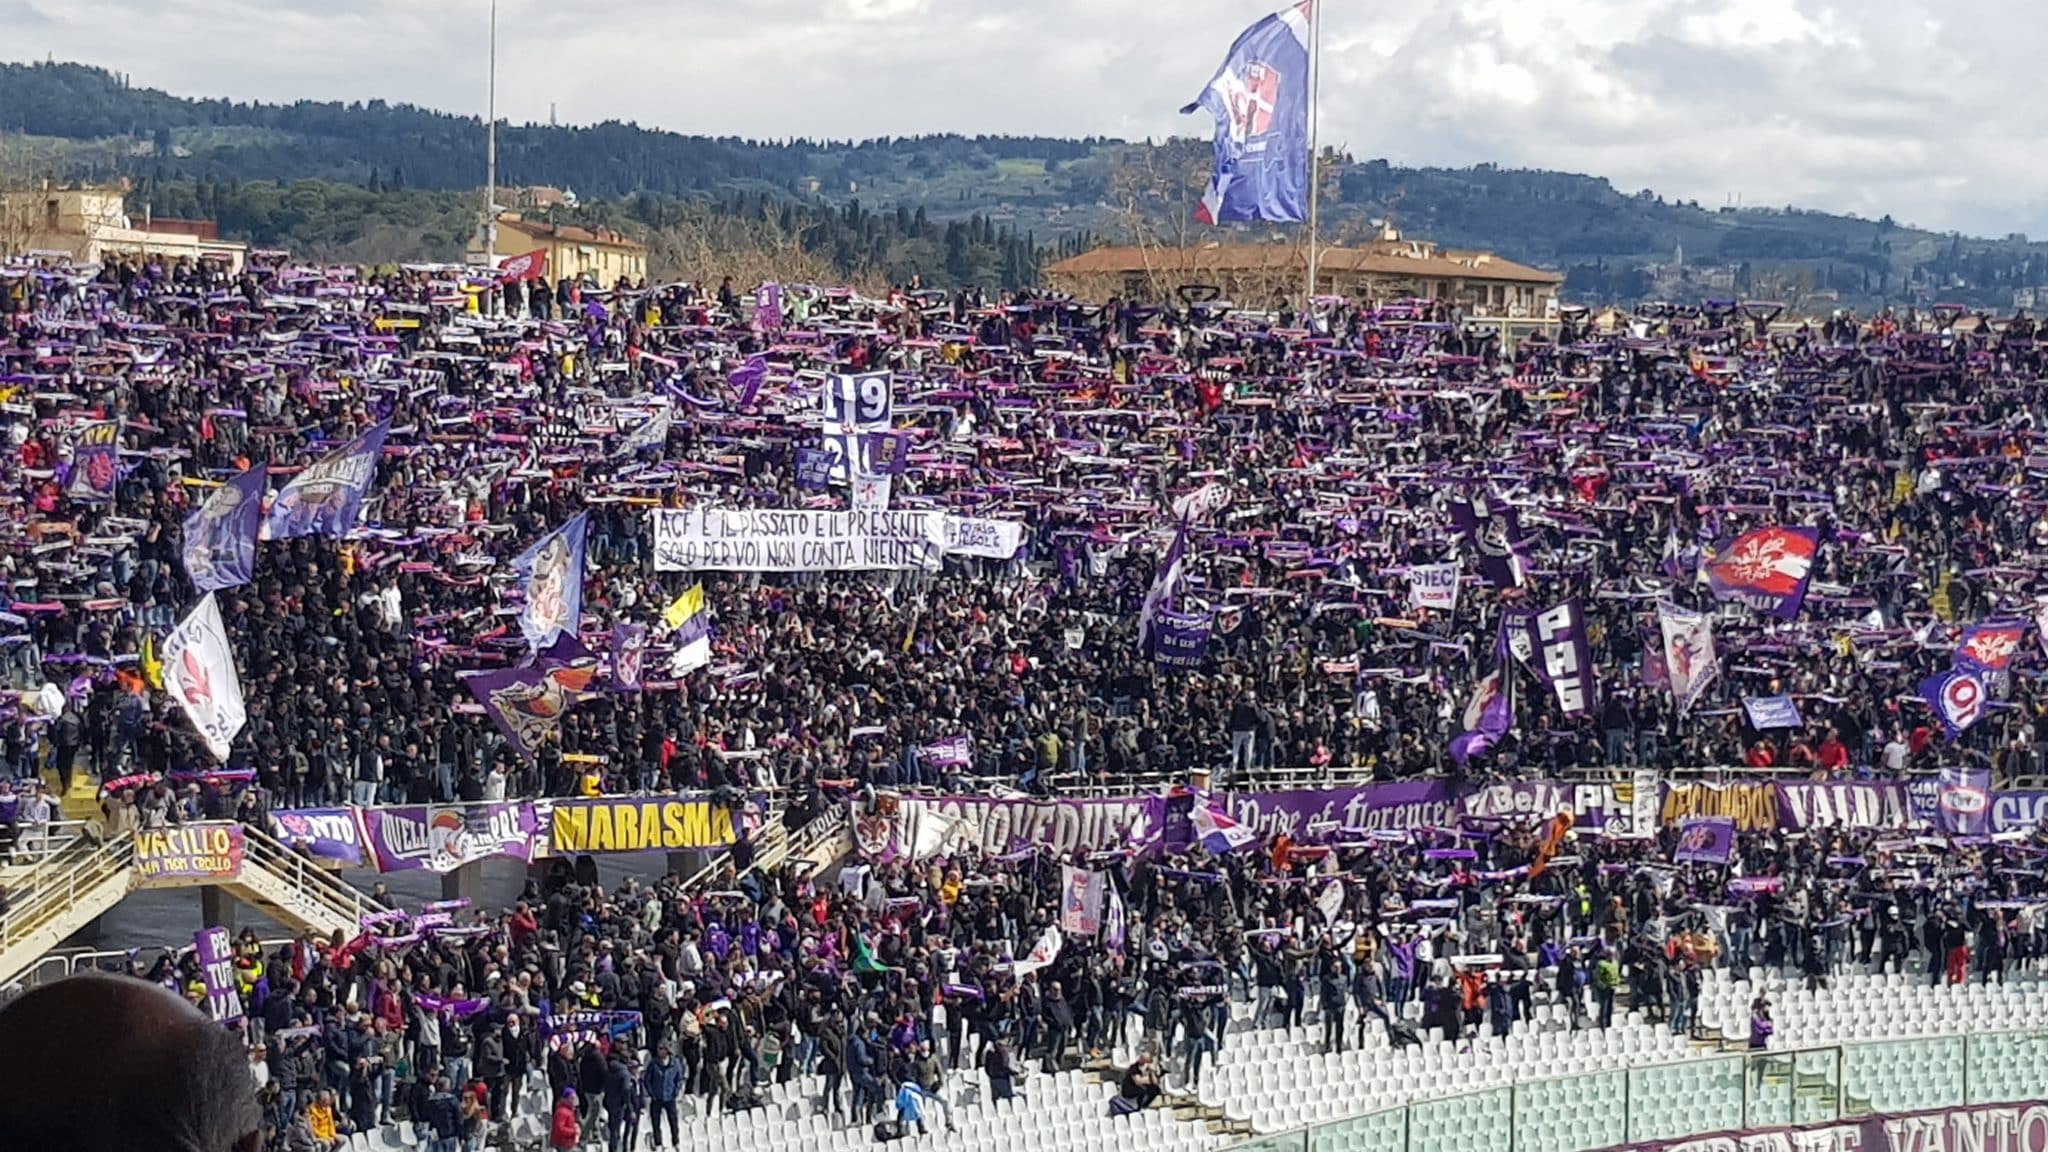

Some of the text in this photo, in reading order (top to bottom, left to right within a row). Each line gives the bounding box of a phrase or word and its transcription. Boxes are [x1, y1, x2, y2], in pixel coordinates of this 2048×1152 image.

[659, 511, 691, 537] ACF
[738, 511, 808, 538] PASSATO
[815, 513, 825, 537] E
[830, 513, 844, 537] IL
[848, 511, 928, 538] PRESENTE
[659, 541, 696, 566] SOLO
[703, 541, 731, 566] PER
[734, 541, 760, 566] VOI
[767, 541, 795, 567] NON
[802, 541, 856, 567] CONTA
[553, 801, 736, 851] MARASMA
[136, 827, 230, 859] VACILLO
